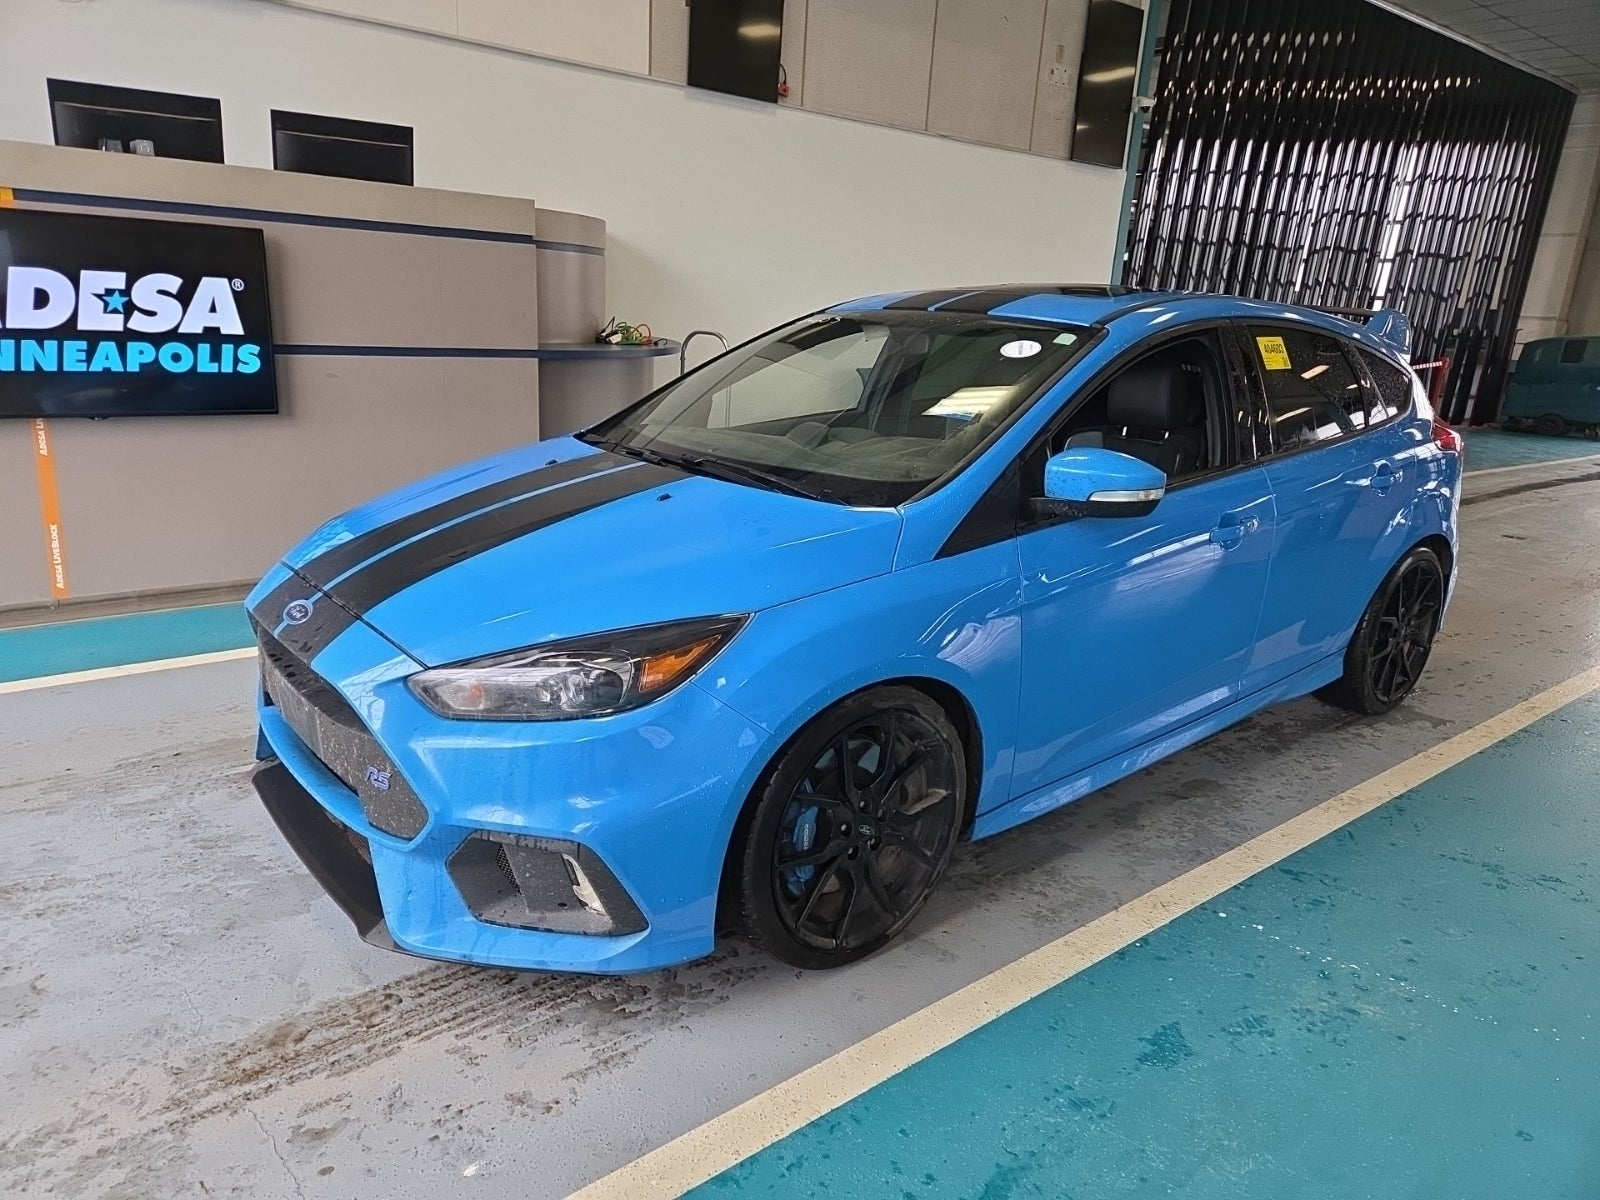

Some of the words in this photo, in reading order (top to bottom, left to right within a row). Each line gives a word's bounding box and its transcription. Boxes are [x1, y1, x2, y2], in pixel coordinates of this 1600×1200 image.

[38, 430, 48, 456] ADESA
[56, 565, 65, 589] ADESA
[364, 766, 392, 790] RS
